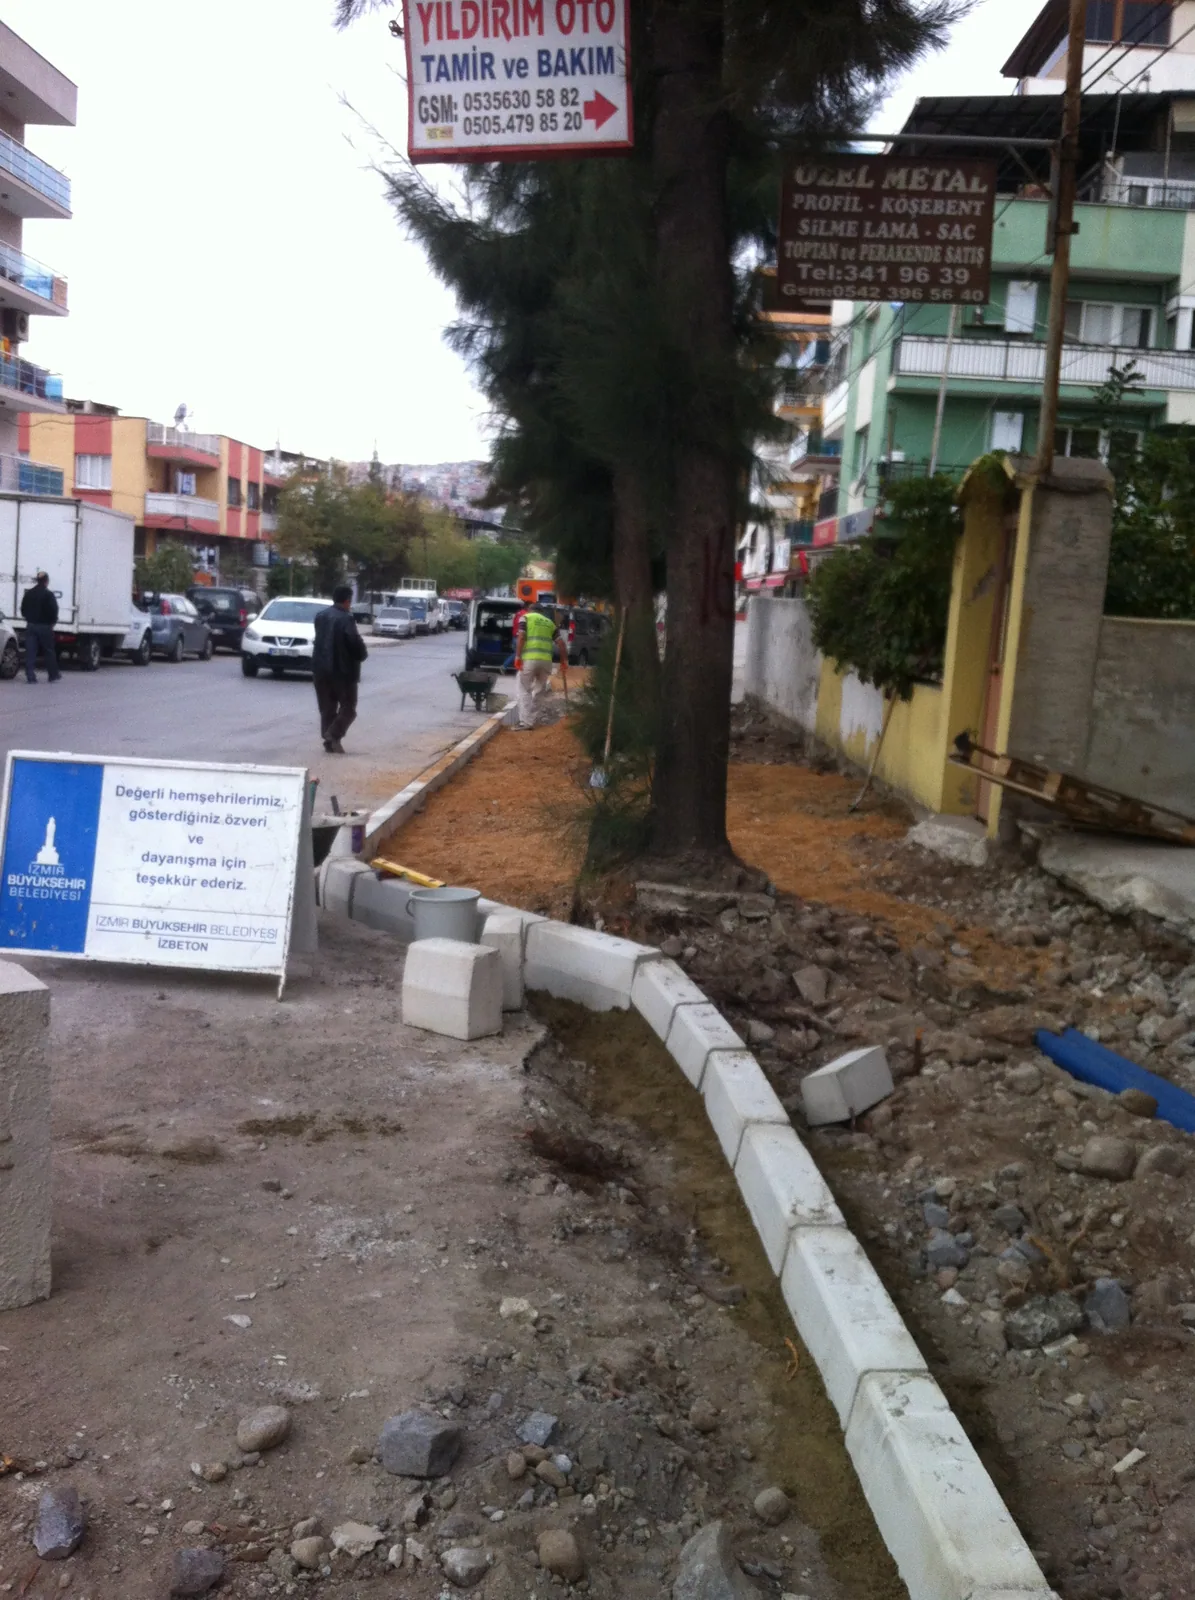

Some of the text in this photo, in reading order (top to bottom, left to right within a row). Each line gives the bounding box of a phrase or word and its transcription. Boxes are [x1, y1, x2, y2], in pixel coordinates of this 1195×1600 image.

[416, 0, 615, 46] YILDIRIM OTO
[421, 45, 615, 83] TAMİR ve BAKIM
[536, 89, 555, 109] 58
[560, 88, 580, 107] 82
[418, 94, 458, 124] GSM:
[540, 113, 559, 131] 85
[563, 111, 582, 131] 20
[881, 166, 988, 194] METAL
[862, 220, 920, 239] LAMA
[785, 240, 839, 260] TOPTAN
[858, 243, 942, 263] PERAKENDE
[899, 266, 930, 284] 96
[939, 267, 970, 285] 39
[887, 286, 923, 300] 396
[960, 288, 984, 302] 40
[115, 785, 164, 800] Değerli
[129, 808, 267, 827] gösterdiğiniz özveri
[188, 834, 204, 845] ve
[141, 851, 246, 870] dayanışma için
[136, 872, 246, 890] teşekkür ederiz.
